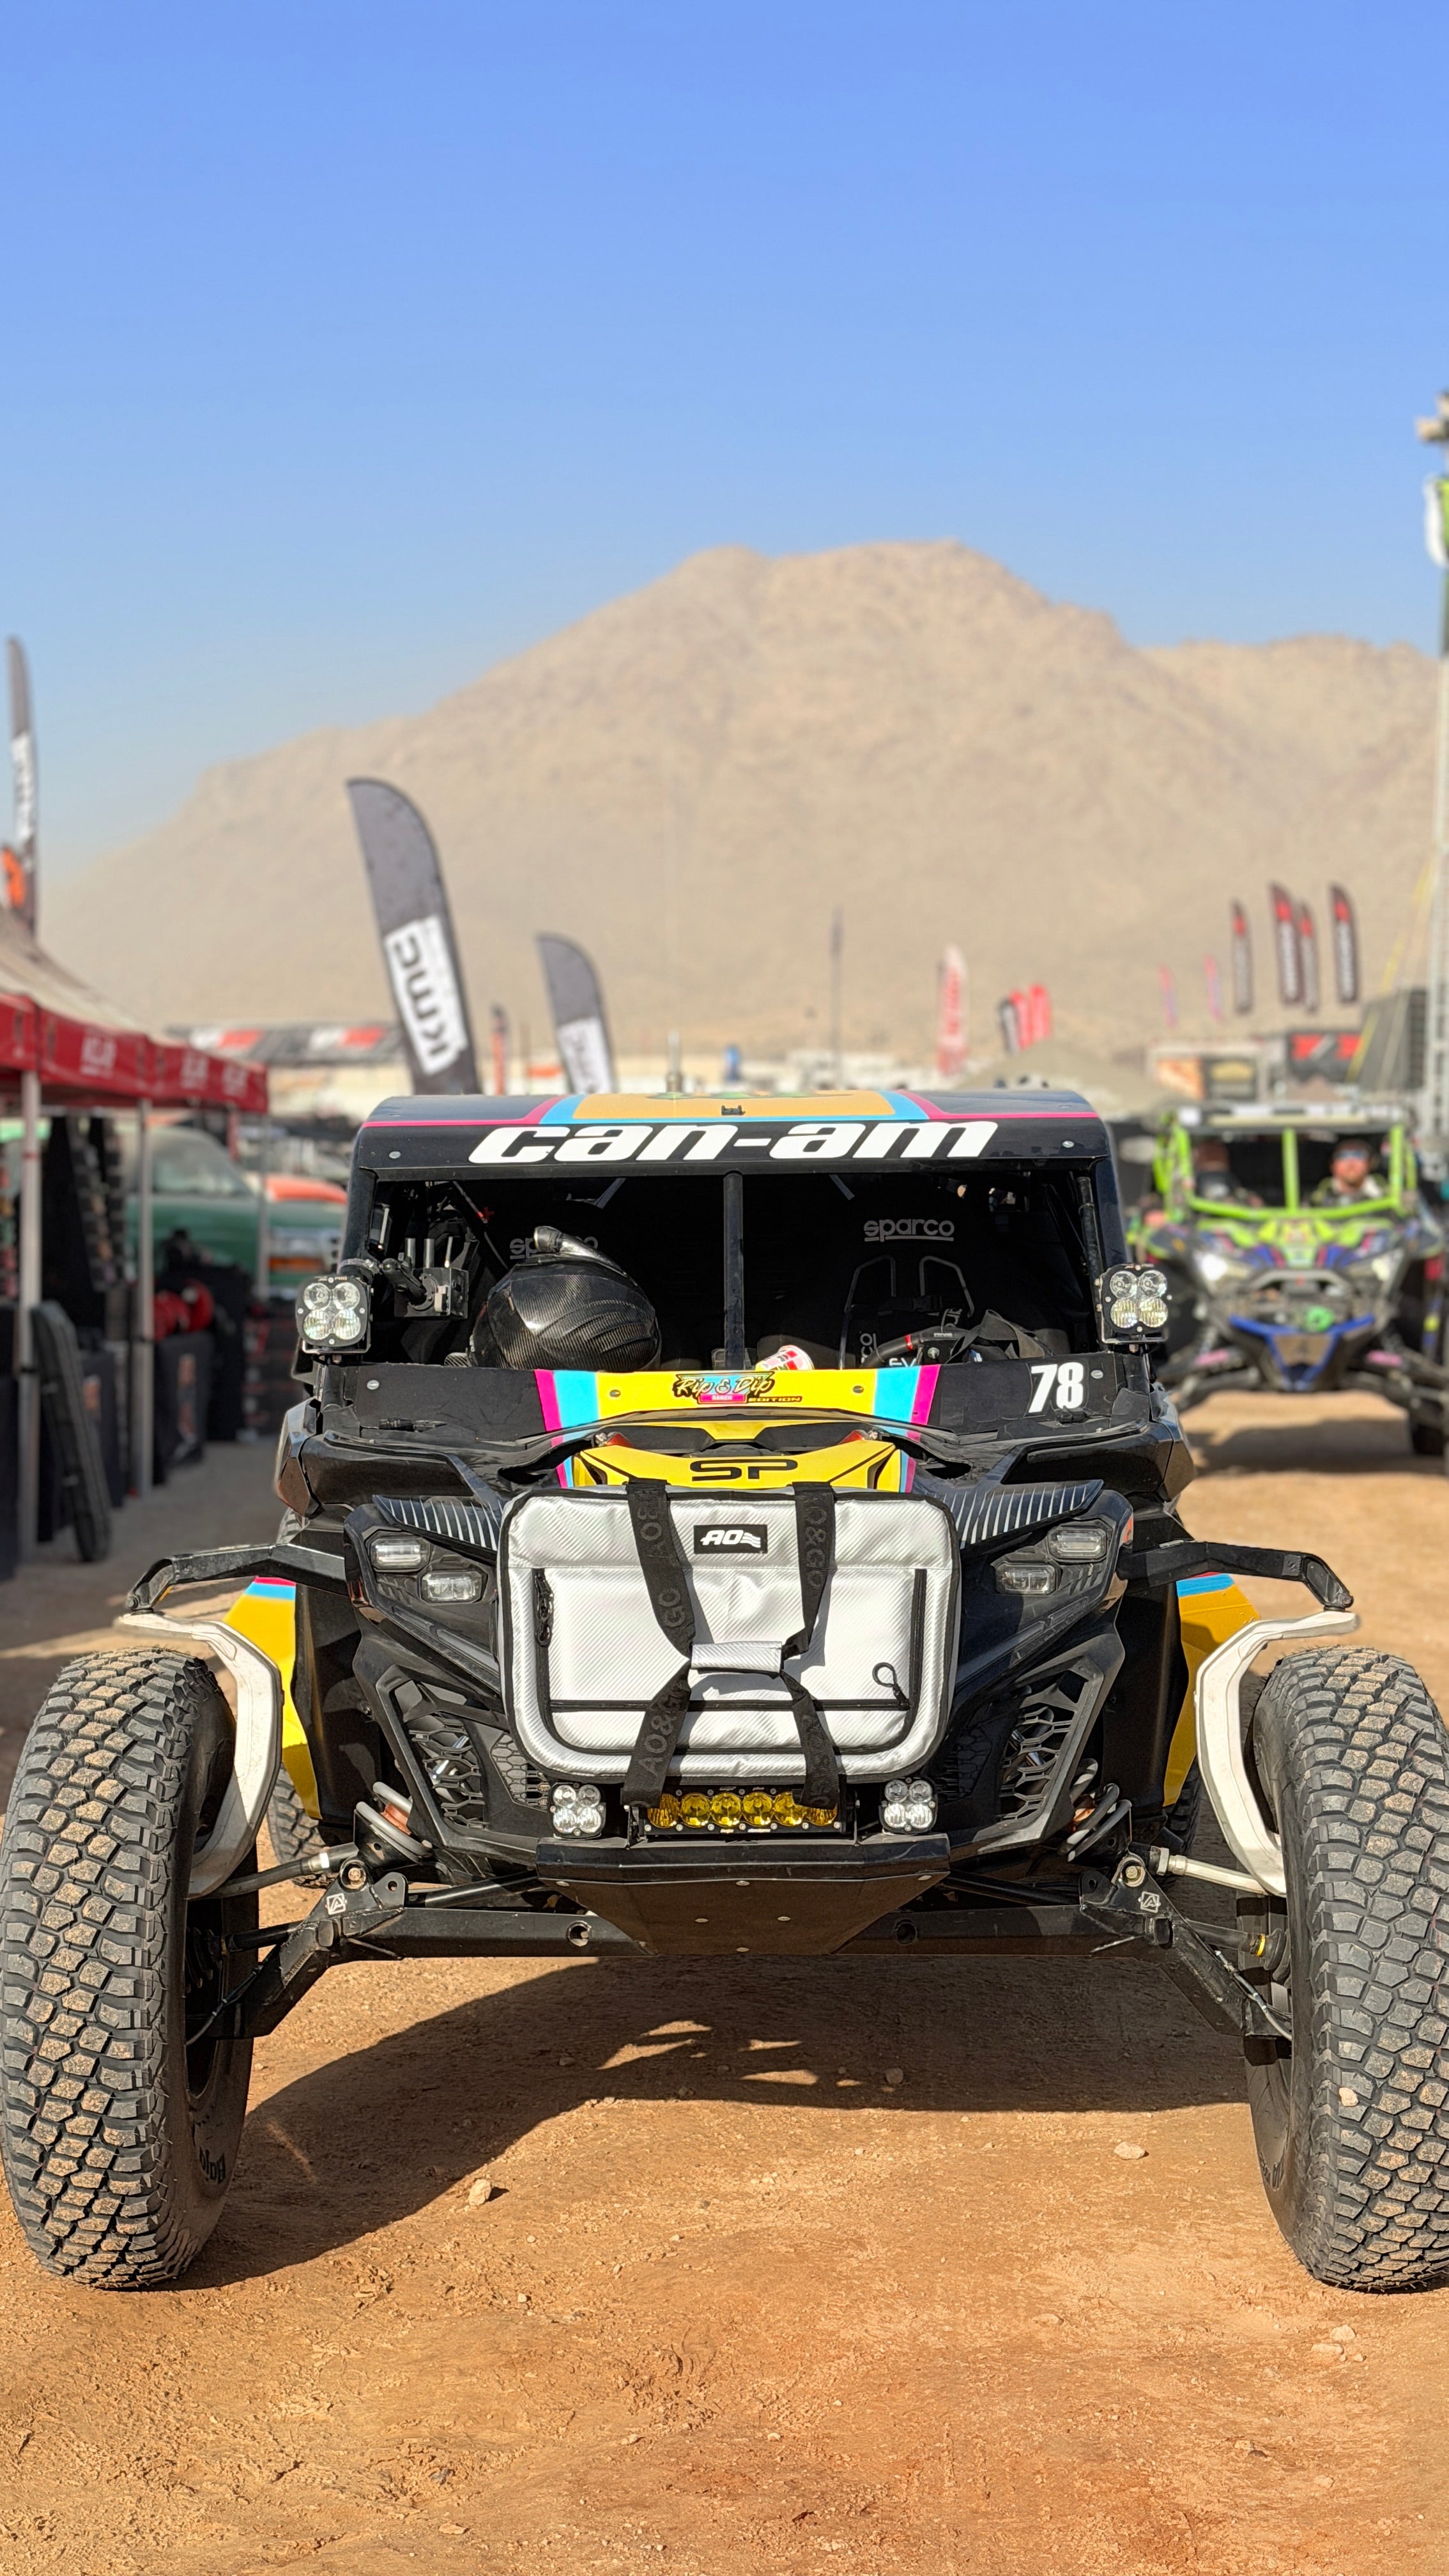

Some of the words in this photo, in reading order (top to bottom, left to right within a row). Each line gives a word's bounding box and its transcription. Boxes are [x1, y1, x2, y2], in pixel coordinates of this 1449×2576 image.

[468, 1121, 998, 1163] can-am
[864, 1218, 954, 1242] sparco
[677, 1377, 714, 1398] Rip
[715, 1377, 731, 1395] &
[733, 1376, 775, 1396] Dip
[1028, 1362, 1084, 1413] 78
[690, 1459, 798, 1482] SP
[700, 1530, 744, 1545] AO
